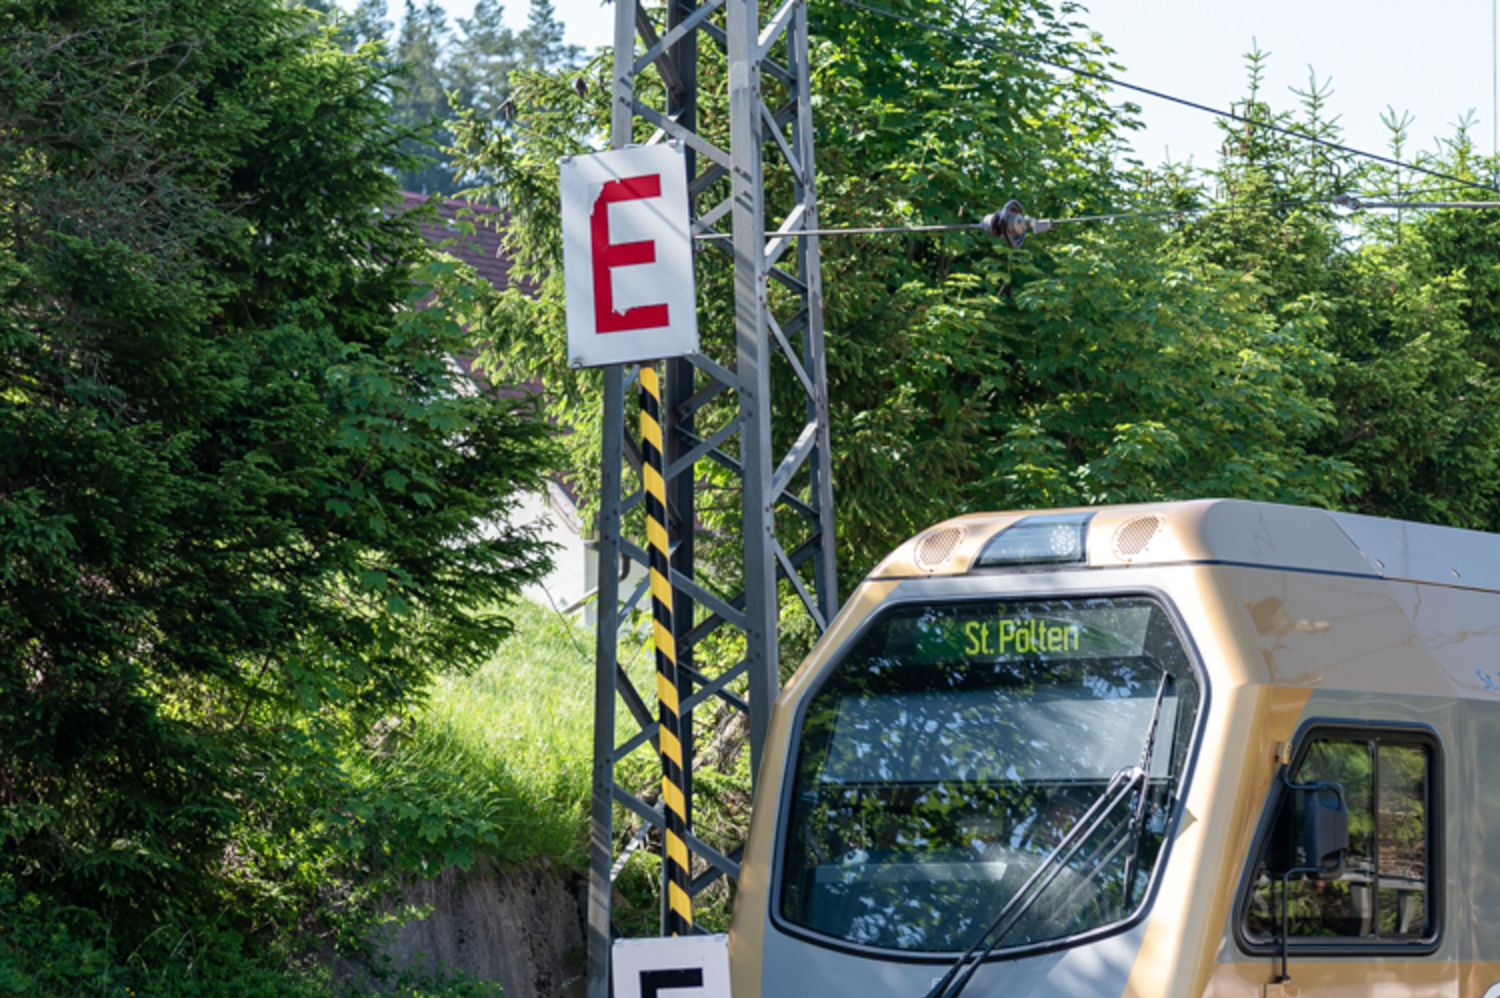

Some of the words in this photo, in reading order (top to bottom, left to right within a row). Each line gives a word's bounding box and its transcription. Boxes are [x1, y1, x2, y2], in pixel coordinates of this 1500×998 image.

[590, 174, 669, 333] E
[965, 620, 995, 656] St.
[999, 618, 1080, 654] Pölten
[1475, 668, 1500, 691] St.
